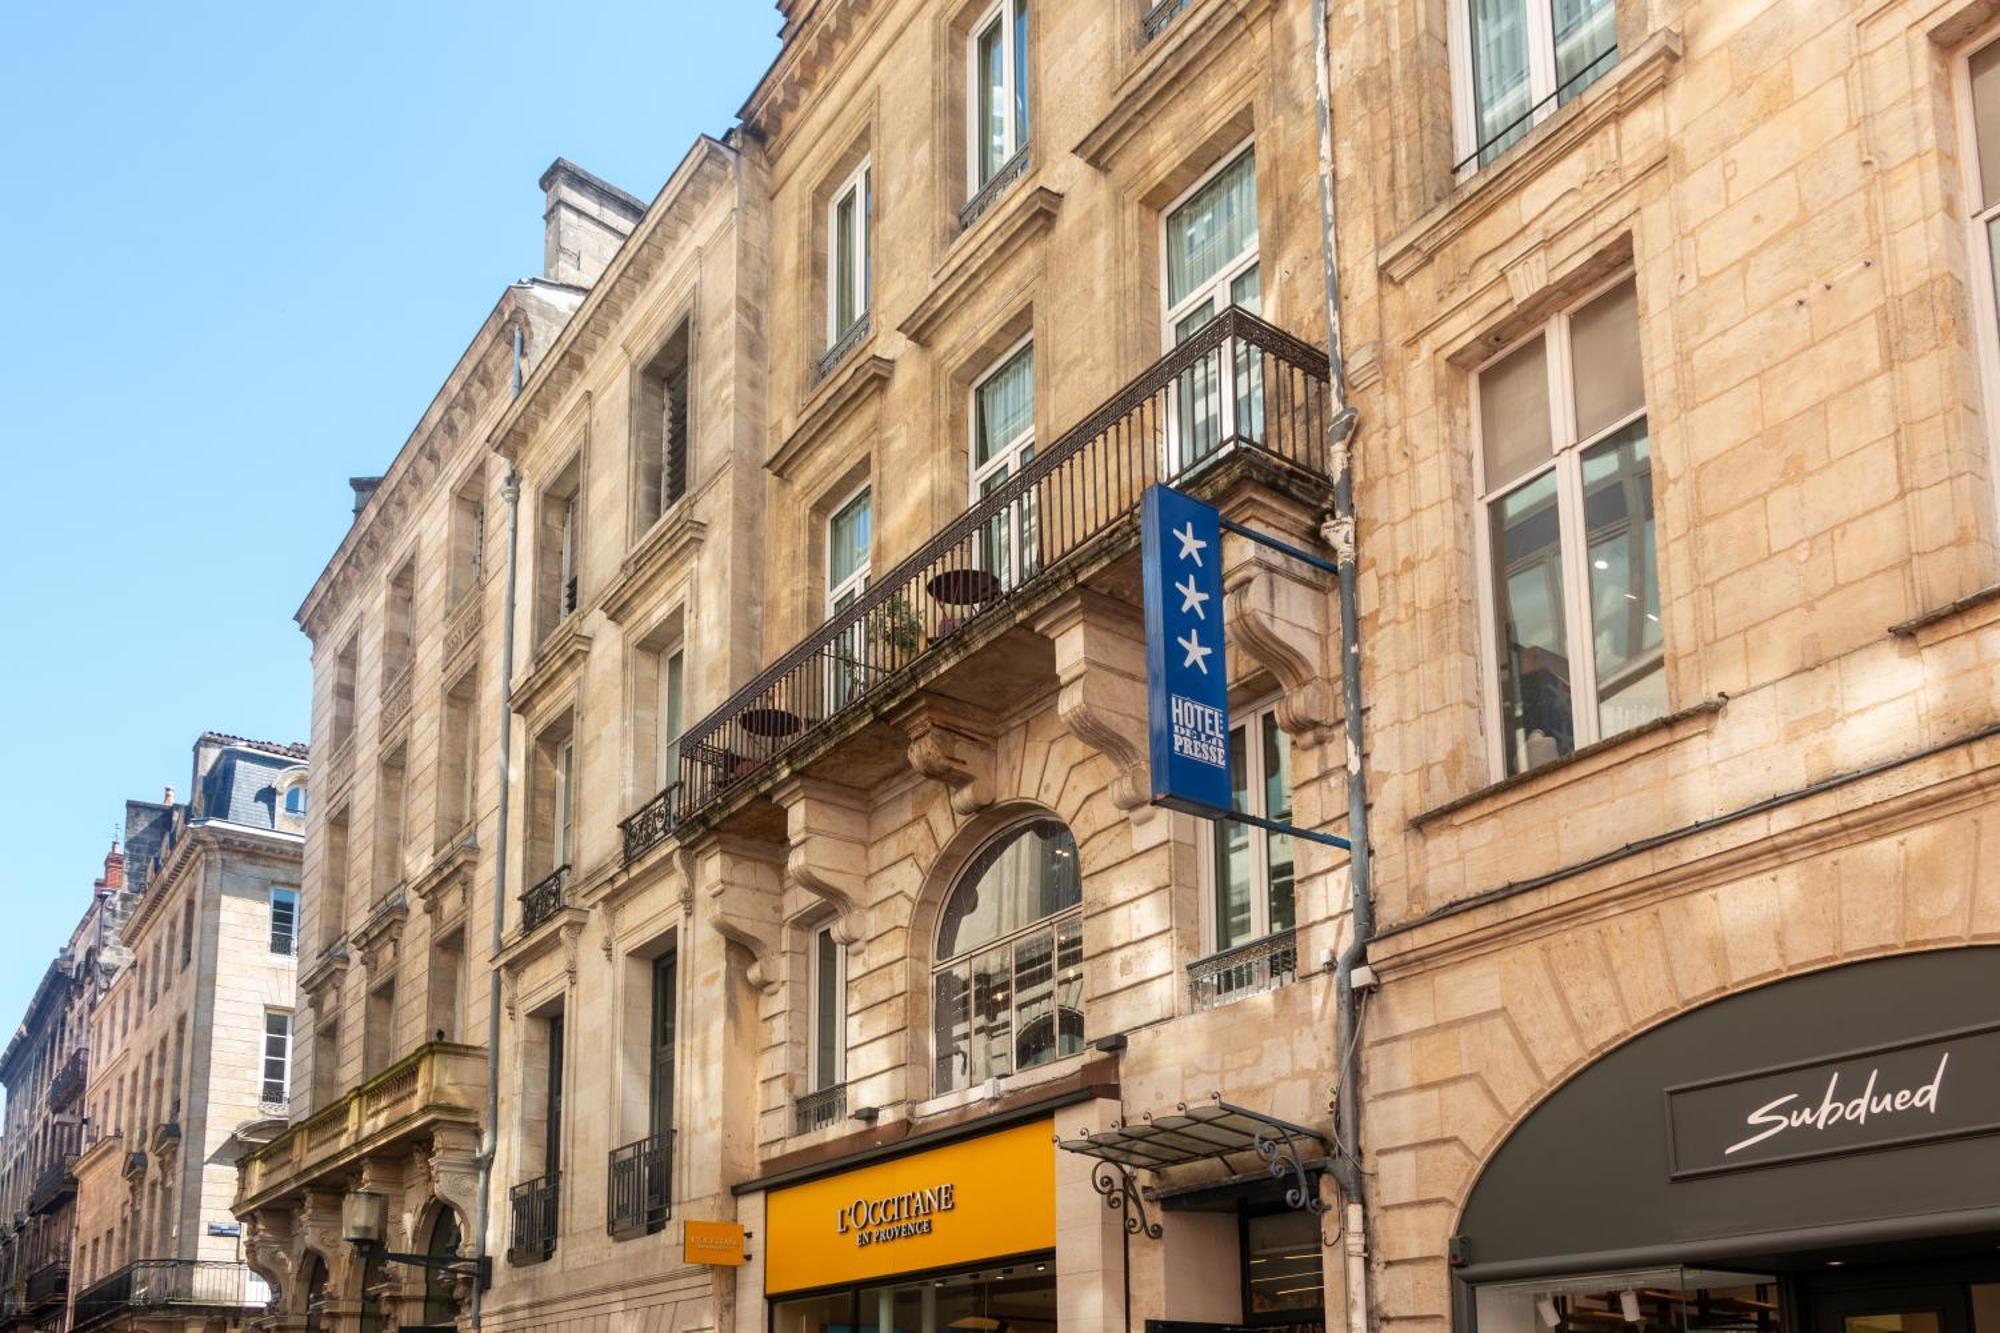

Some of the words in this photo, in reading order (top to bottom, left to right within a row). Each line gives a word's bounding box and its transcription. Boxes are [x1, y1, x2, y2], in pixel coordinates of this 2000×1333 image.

[1174, 725, 1197, 739] DE
[1174, 734, 1225, 766] PRESSE
[1725, 1052, 1949, 1155] Subdued
[837, 1184, 954, 1233] L'OCCITANE
[857, 1232, 872, 1247] EN
[875, 1220, 931, 1242] PROVENCE
